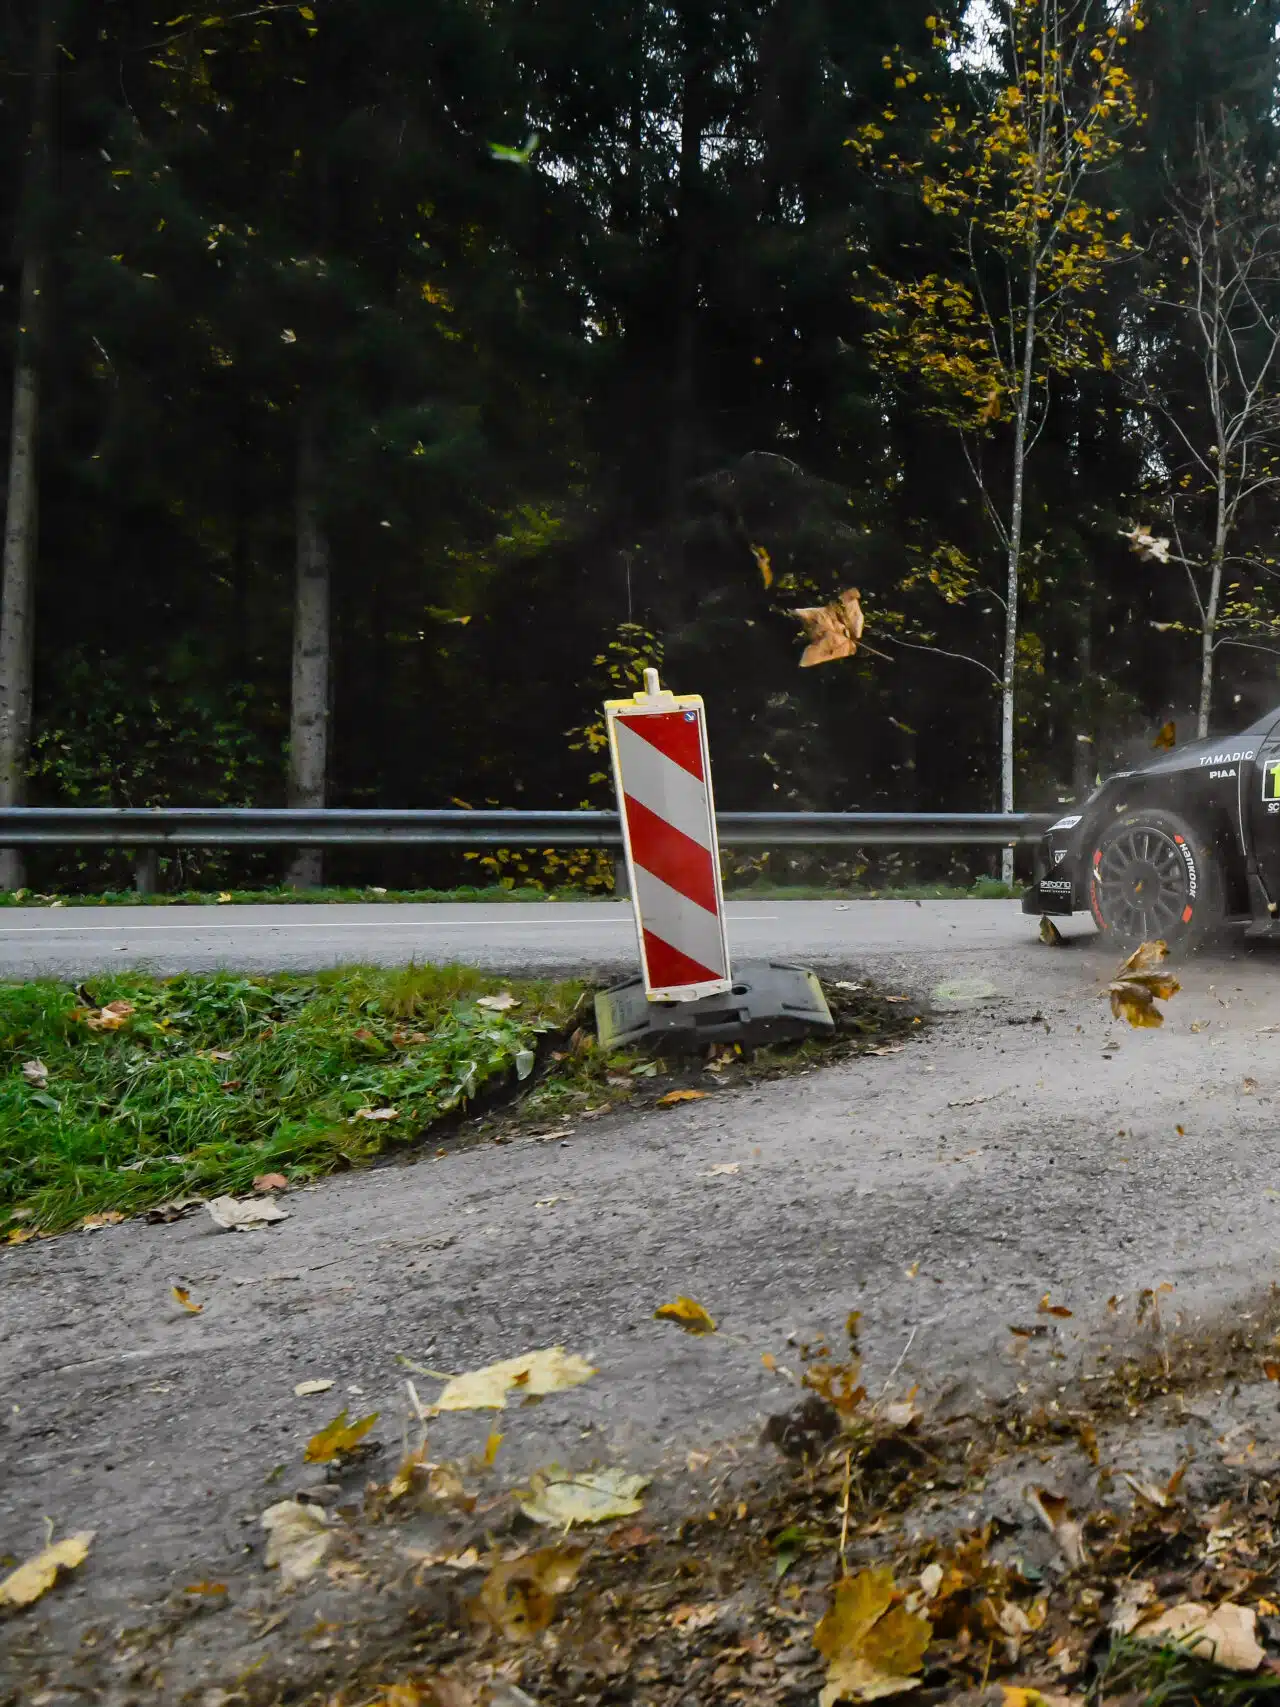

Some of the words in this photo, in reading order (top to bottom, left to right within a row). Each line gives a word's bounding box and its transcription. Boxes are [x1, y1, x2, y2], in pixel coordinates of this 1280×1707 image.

[1200, 751, 1254, 766] TAMADIC
[1209, 769, 1237, 779] PIAA
[1267, 802, 1280, 812] SC
